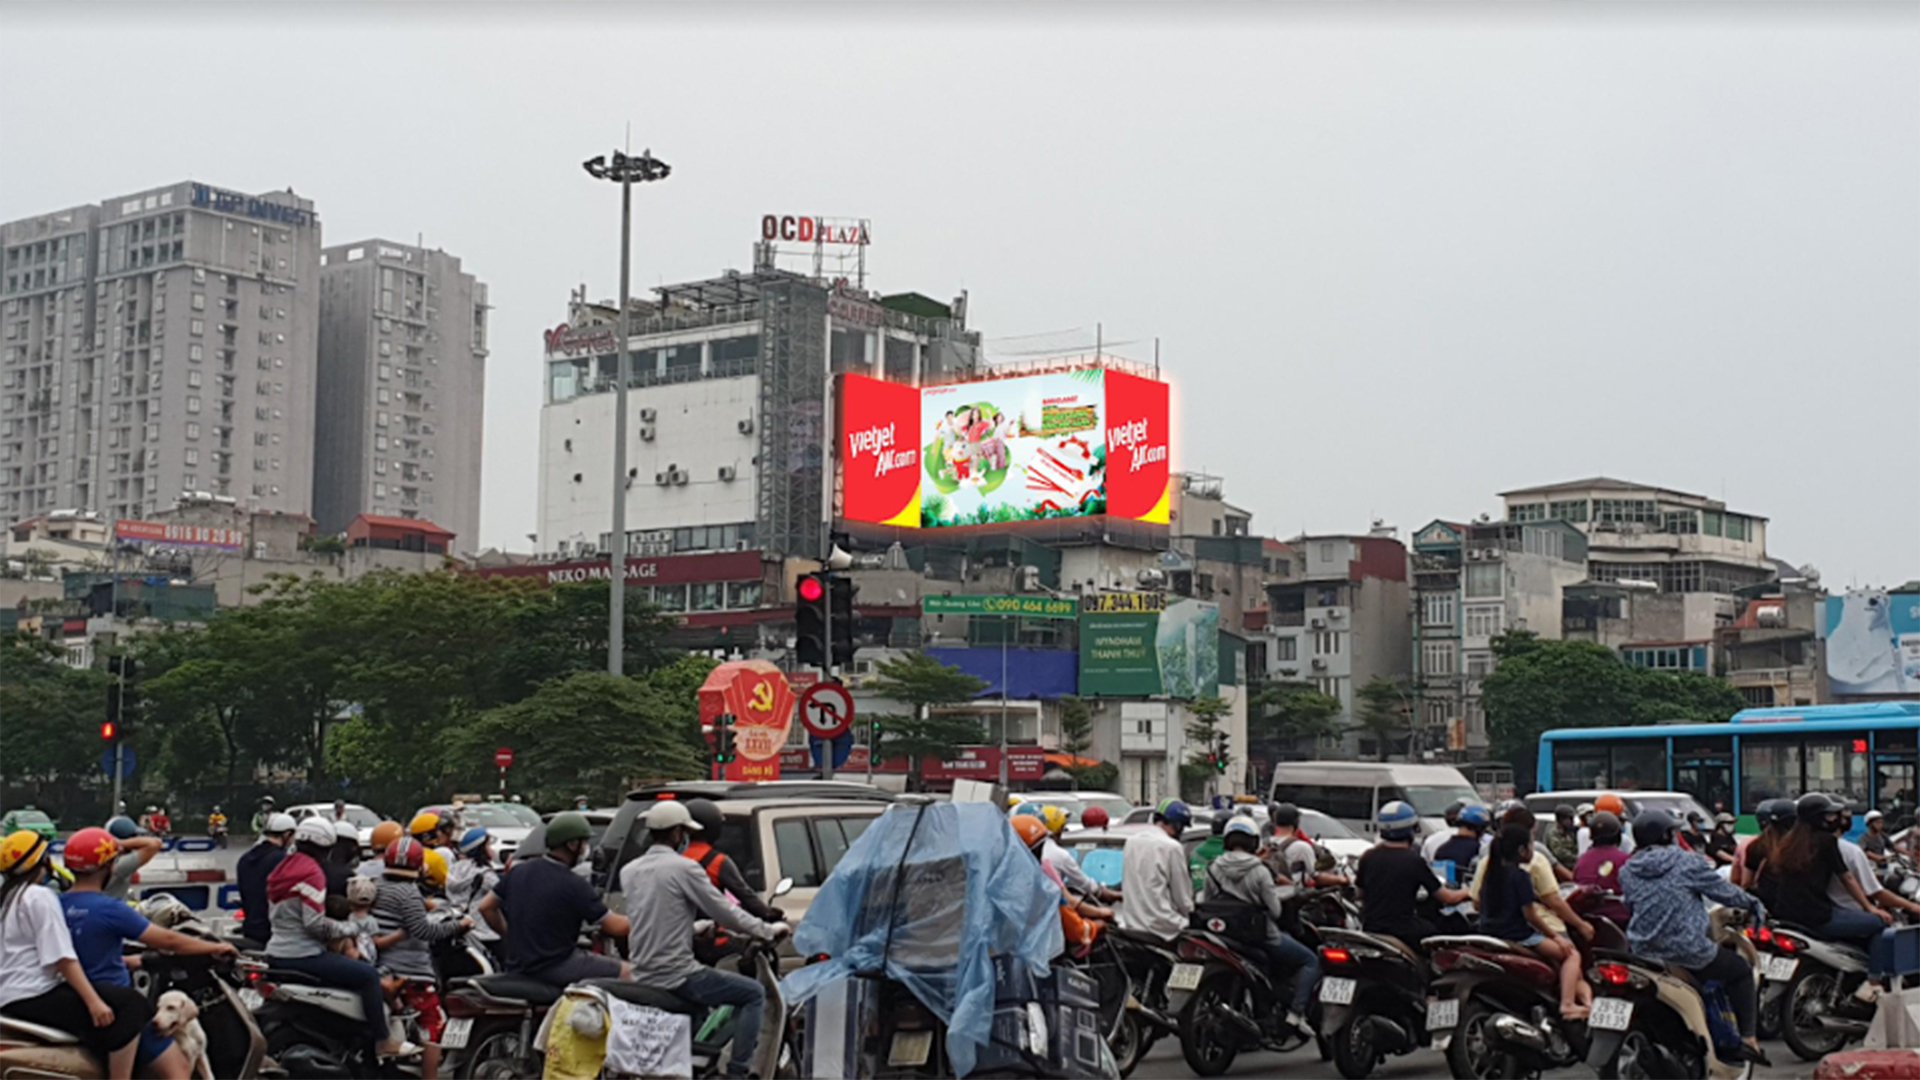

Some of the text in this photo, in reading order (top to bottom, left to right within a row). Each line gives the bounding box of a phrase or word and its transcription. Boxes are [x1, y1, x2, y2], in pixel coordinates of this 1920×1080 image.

[762, 214, 871, 245] OCD PLAZA
[547, 562, 658, 584] NEKO MASAGE
[995, 597, 1021, 611] 090
[1022, 601, 1043, 613] 464
[1084, 592, 1167, 612] 097.344.1905
